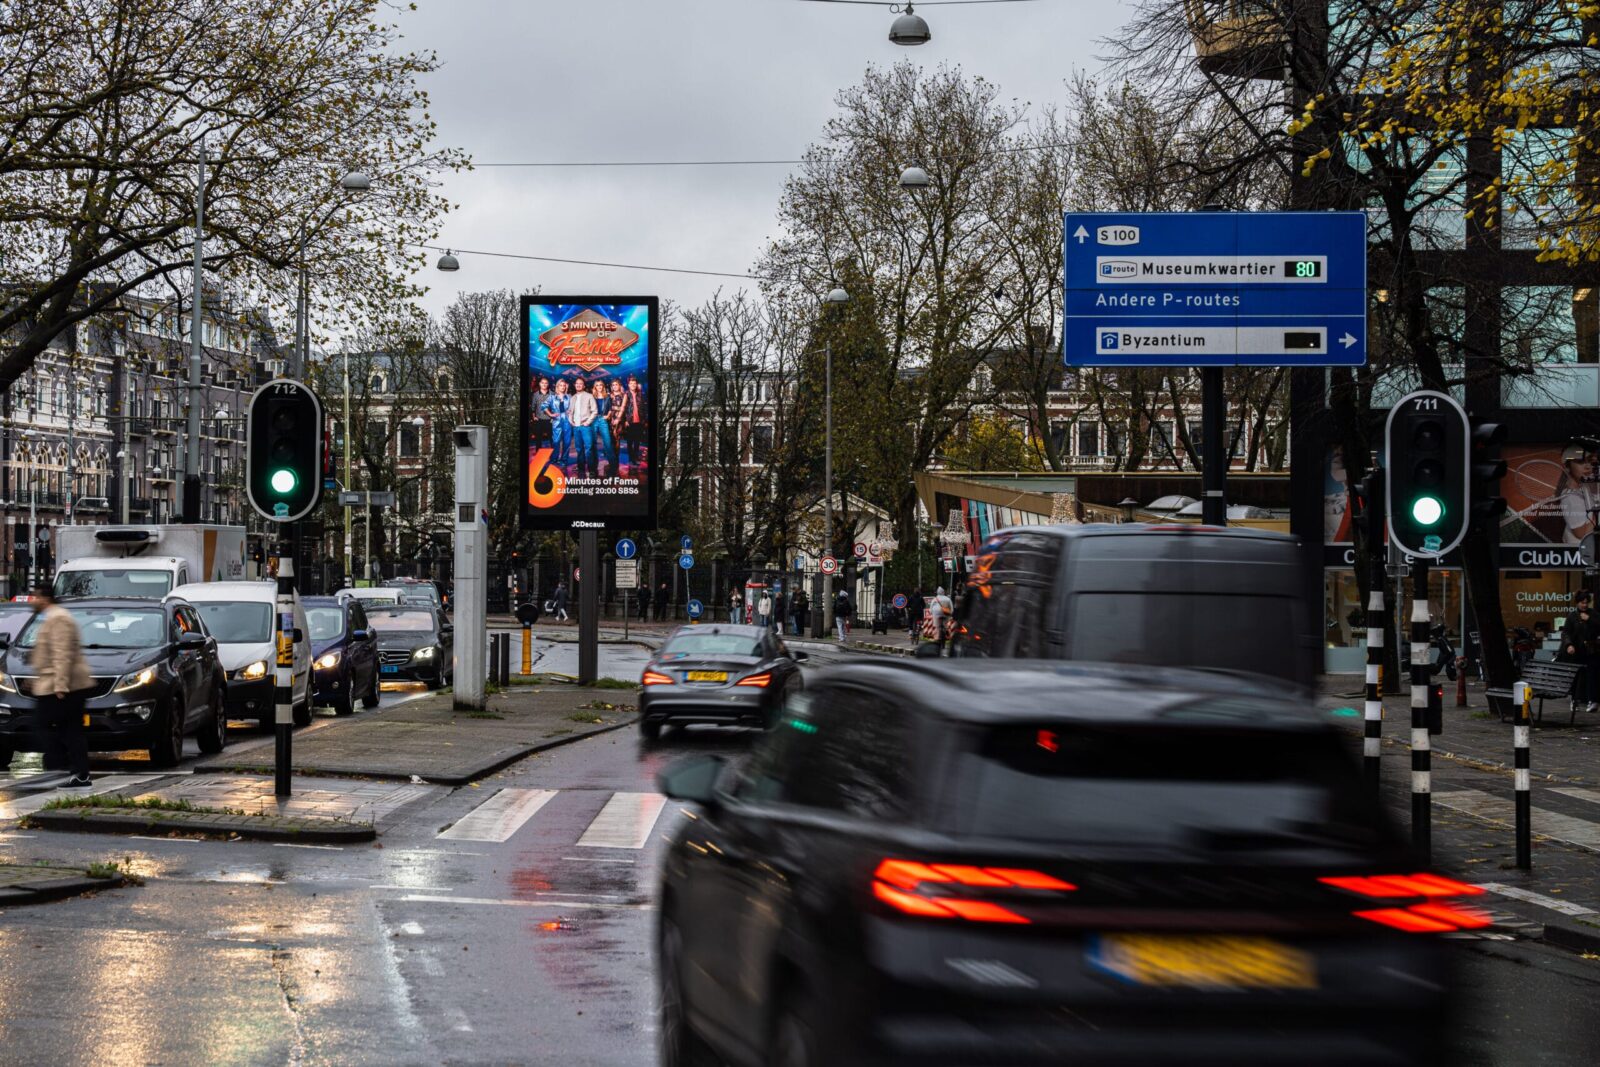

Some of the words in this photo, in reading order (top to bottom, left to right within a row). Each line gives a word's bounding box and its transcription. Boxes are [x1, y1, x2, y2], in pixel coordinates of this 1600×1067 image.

[1100, 230, 1109, 240] S
[1114, 230, 1136, 240] 100
[1142, 262, 1276, 275] Museumkwartier
[1296, 262, 1315, 276] 80
[1096, 293, 1156, 306] Andere
[1163, 293, 1240, 306] P-routes
[561, 321, 568, 330] 3
[570, 322, 617, 330] MINUTES
[1122, 334, 1205, 348] Byzantium
[548, 330, 623, 366] Fame
[274, 384, 296, 394] 712
[1414, 398, 1437, 410] 711
[564, 477, 601, 485] Minutes
[603, 477, 612, 485] of
[557, 487, 594, 496] zaterdag
[1519, 550, 1562, 565] Club
[1516, 592, 1543, 601] Club
[1544, 592, 1572, 601] Med
[1516, 604, 1544, 612] Travel
